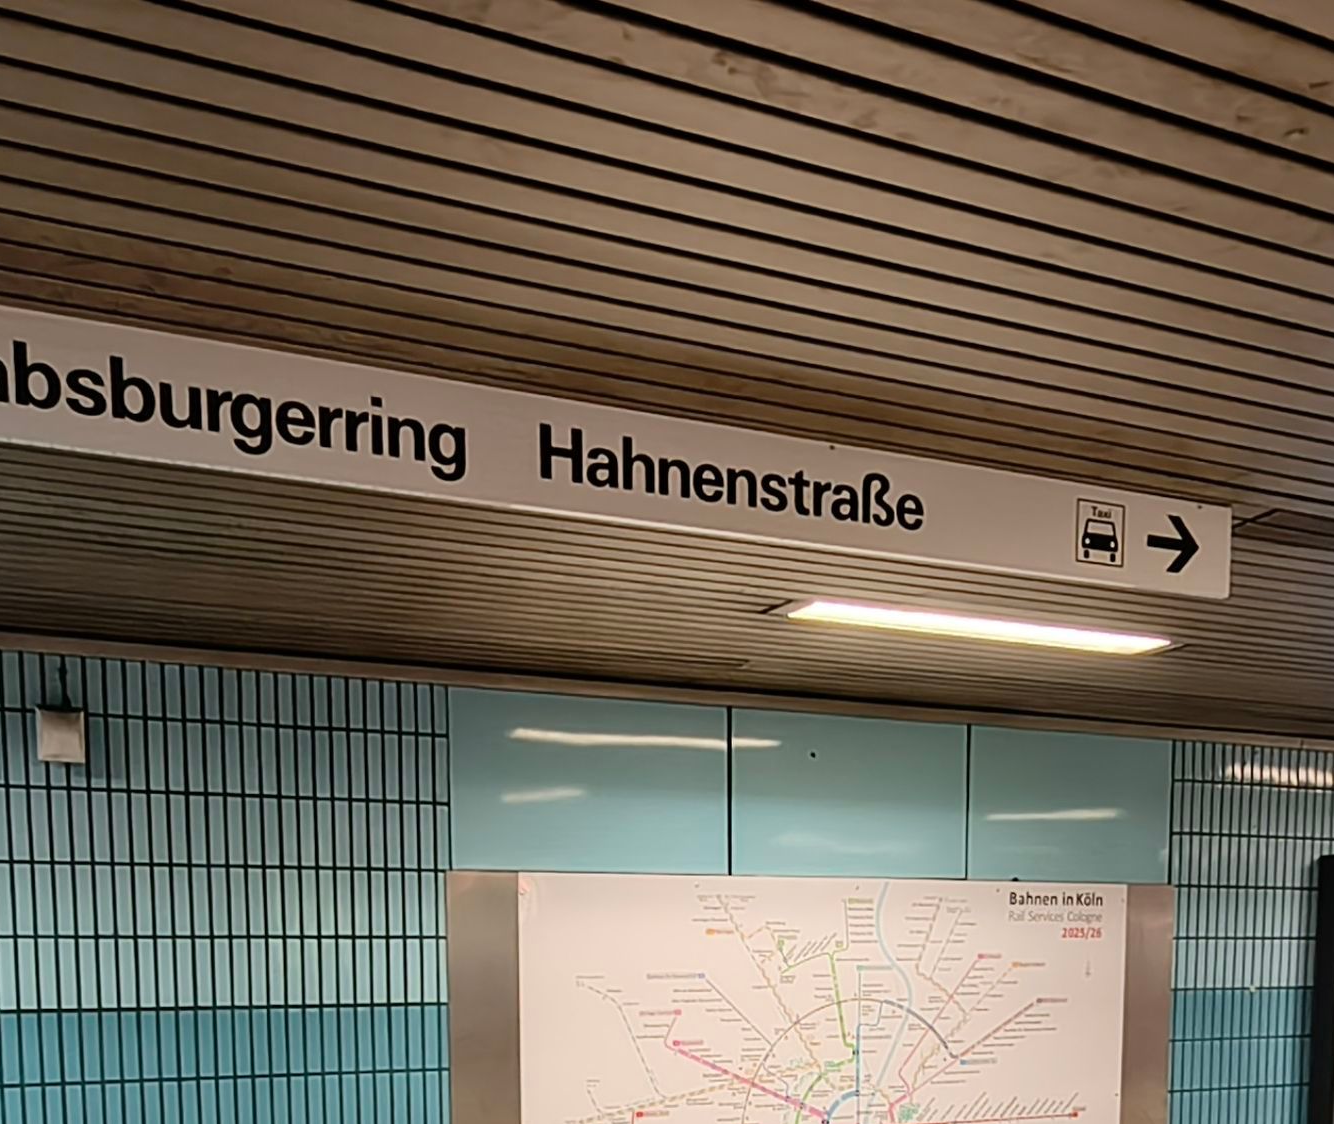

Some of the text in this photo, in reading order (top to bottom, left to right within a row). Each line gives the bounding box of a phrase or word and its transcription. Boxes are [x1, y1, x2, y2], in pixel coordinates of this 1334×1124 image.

[539, 422, 924, 531] Hahnenstraße
[1091, 506, 1112, 519] Taxi
[1009, 891, 1103, 907] Bahnen in Köln
[1008, 910, 1103, 924] Rail Services Cologne
[1061, 927, 1103, 940] 2025/26
